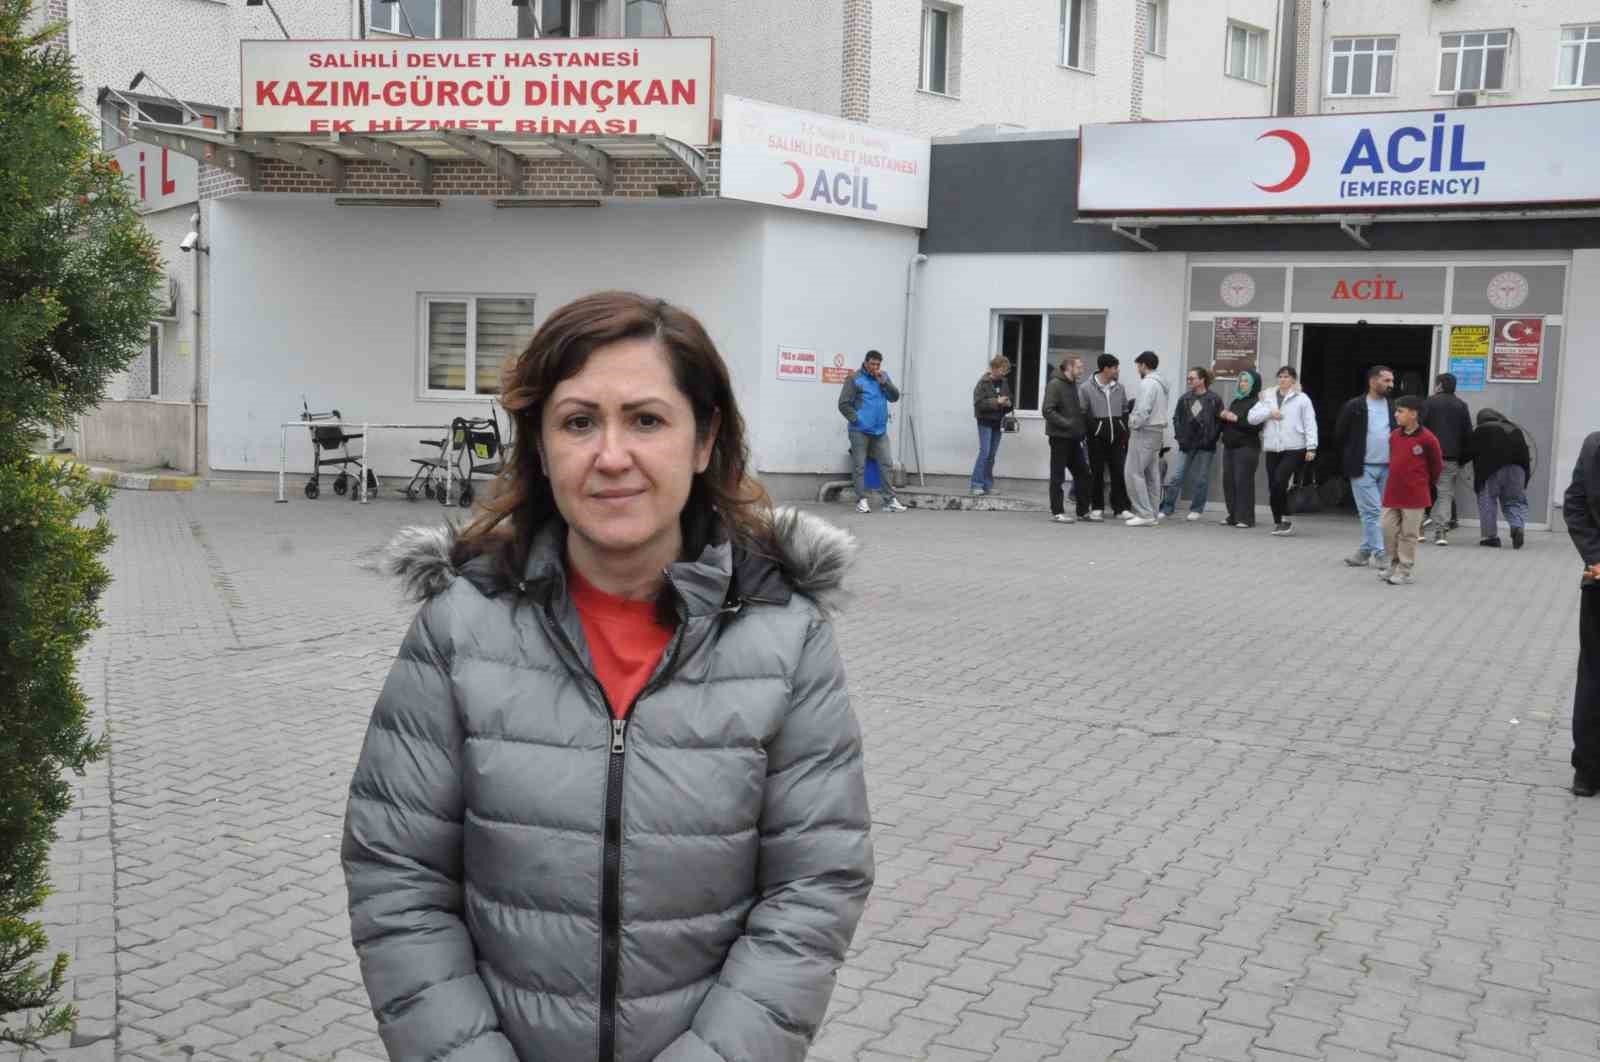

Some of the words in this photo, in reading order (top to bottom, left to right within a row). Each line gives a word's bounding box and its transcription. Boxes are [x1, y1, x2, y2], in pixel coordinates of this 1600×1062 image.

[309, 50, 398, 68] SALİHLİ
[407, 52, 496, 68] DEVLET
[504, 48, 639, 67] HASTANESİ
[255, 75, 511, 107] KAZIM-GÜRCÜ
[524, 73, 697, 112] DİNÇKAN
[310, 119, 354, 134] EK
[1340, 113, 1486, 174] ACİL
[810, 166, 878, 211] ACİL
[1340, 177, 1480, 198] (EMERGENCY)
[1331, 273, 1405, 300] ACİL
